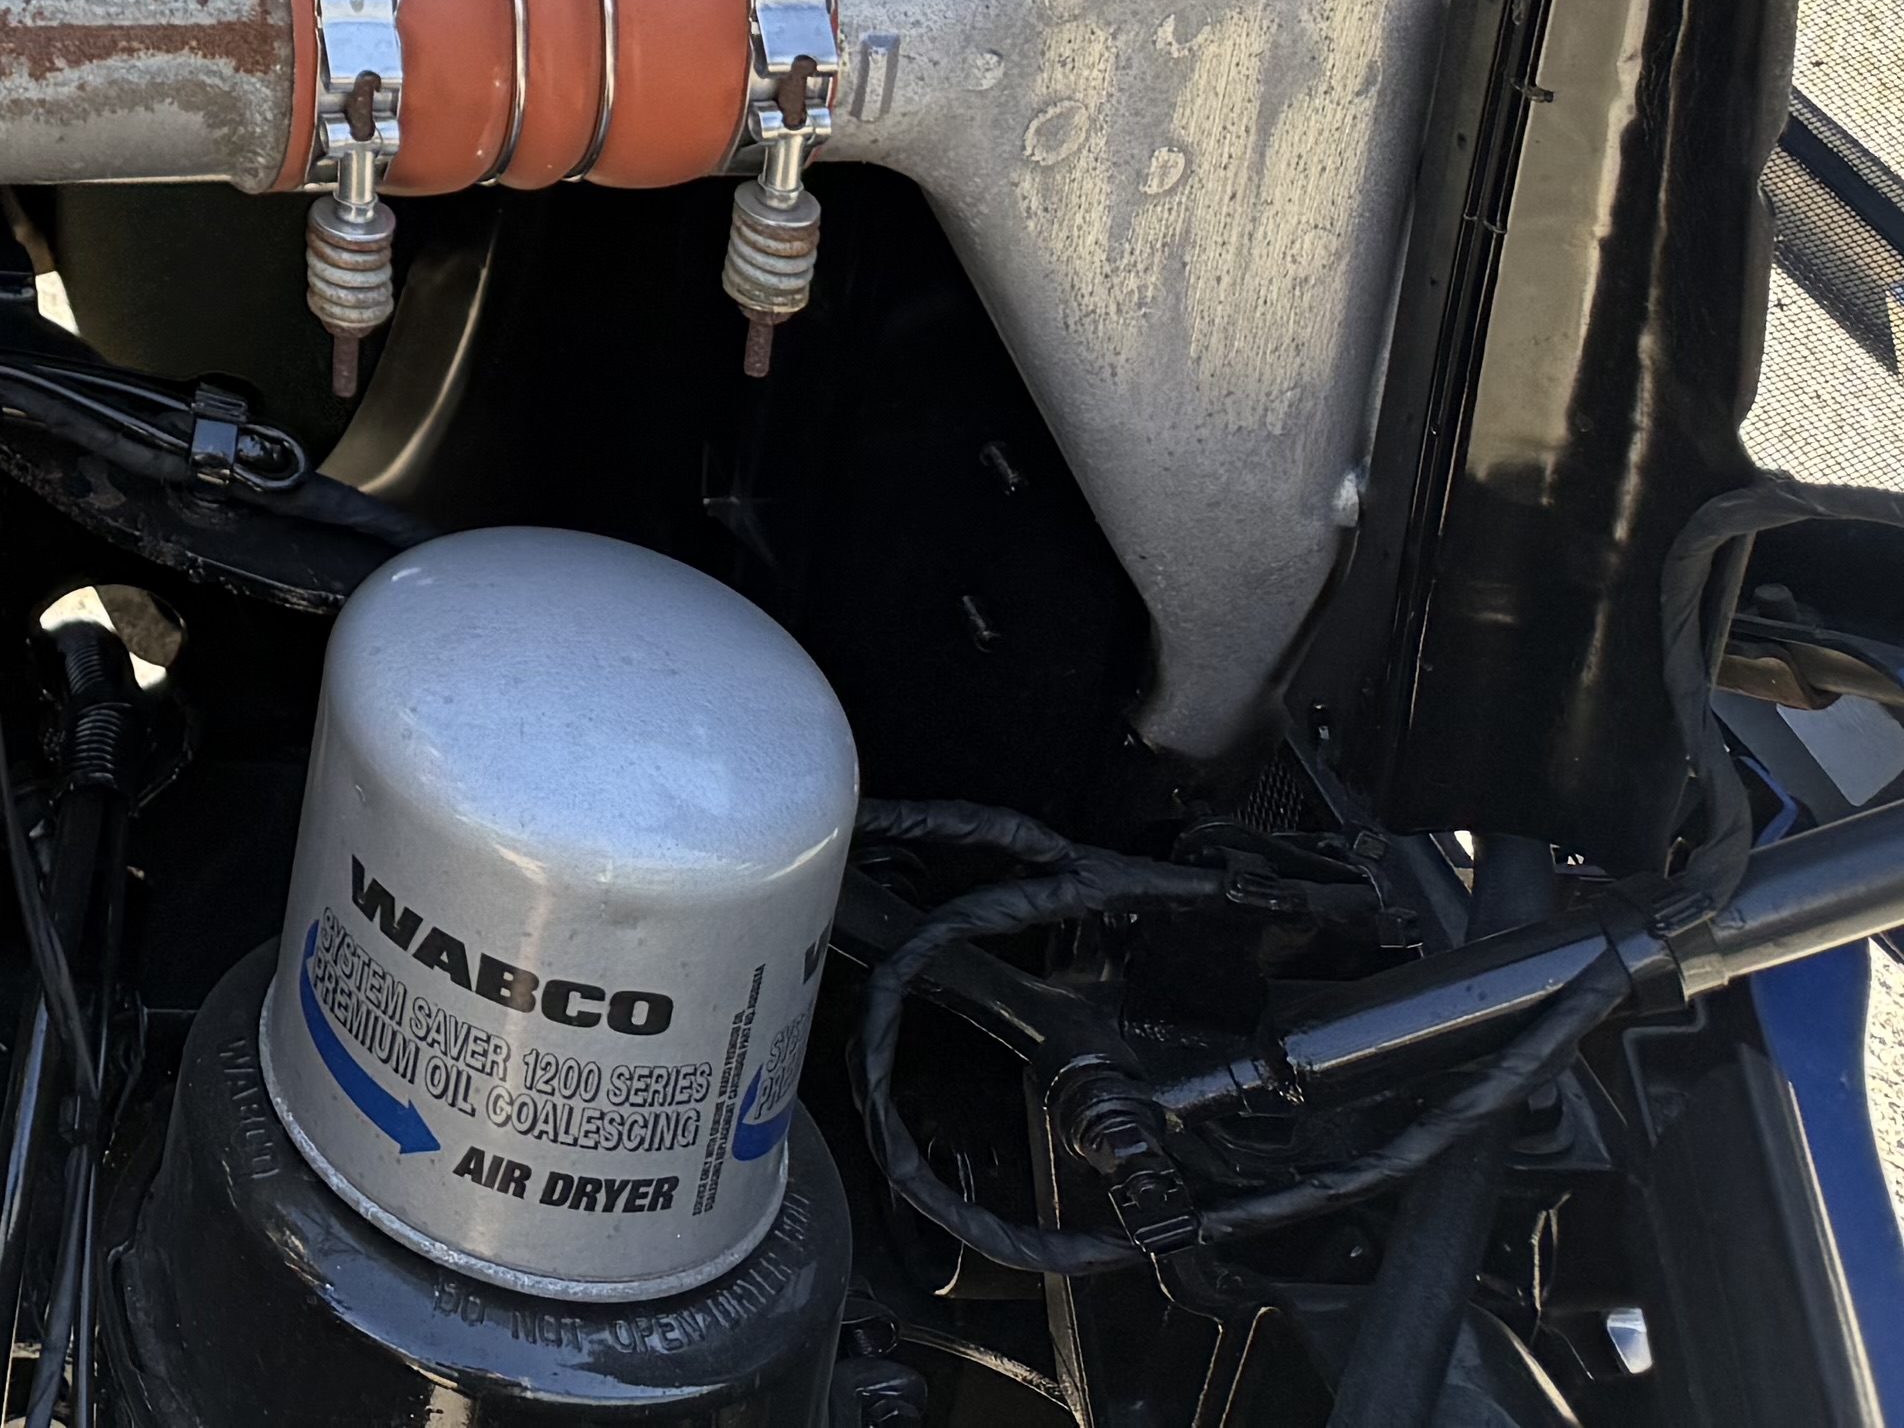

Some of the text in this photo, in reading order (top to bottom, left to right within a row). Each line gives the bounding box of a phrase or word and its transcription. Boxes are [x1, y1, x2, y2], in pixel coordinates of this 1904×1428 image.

[320, 906, 408, 1026] SYSTEM
[410, 995, 510, 1083] SAVER
[521, 1046, 602, 1104] 1200
[605, 1061, 712, 1110] SERIES
[351, 852, 675, 1037] WABCO
[310, 948, 418, 1082] PREMIUM
[423, 1053, 476, 1119] OIL
[484, 1087, 701, 1153] COALESCING
[452, 1145, 681, 1215] AIR DRYER
[510, 1307, 585, 1352] NOT
[609, 1308, 707, 1356] OPEN
